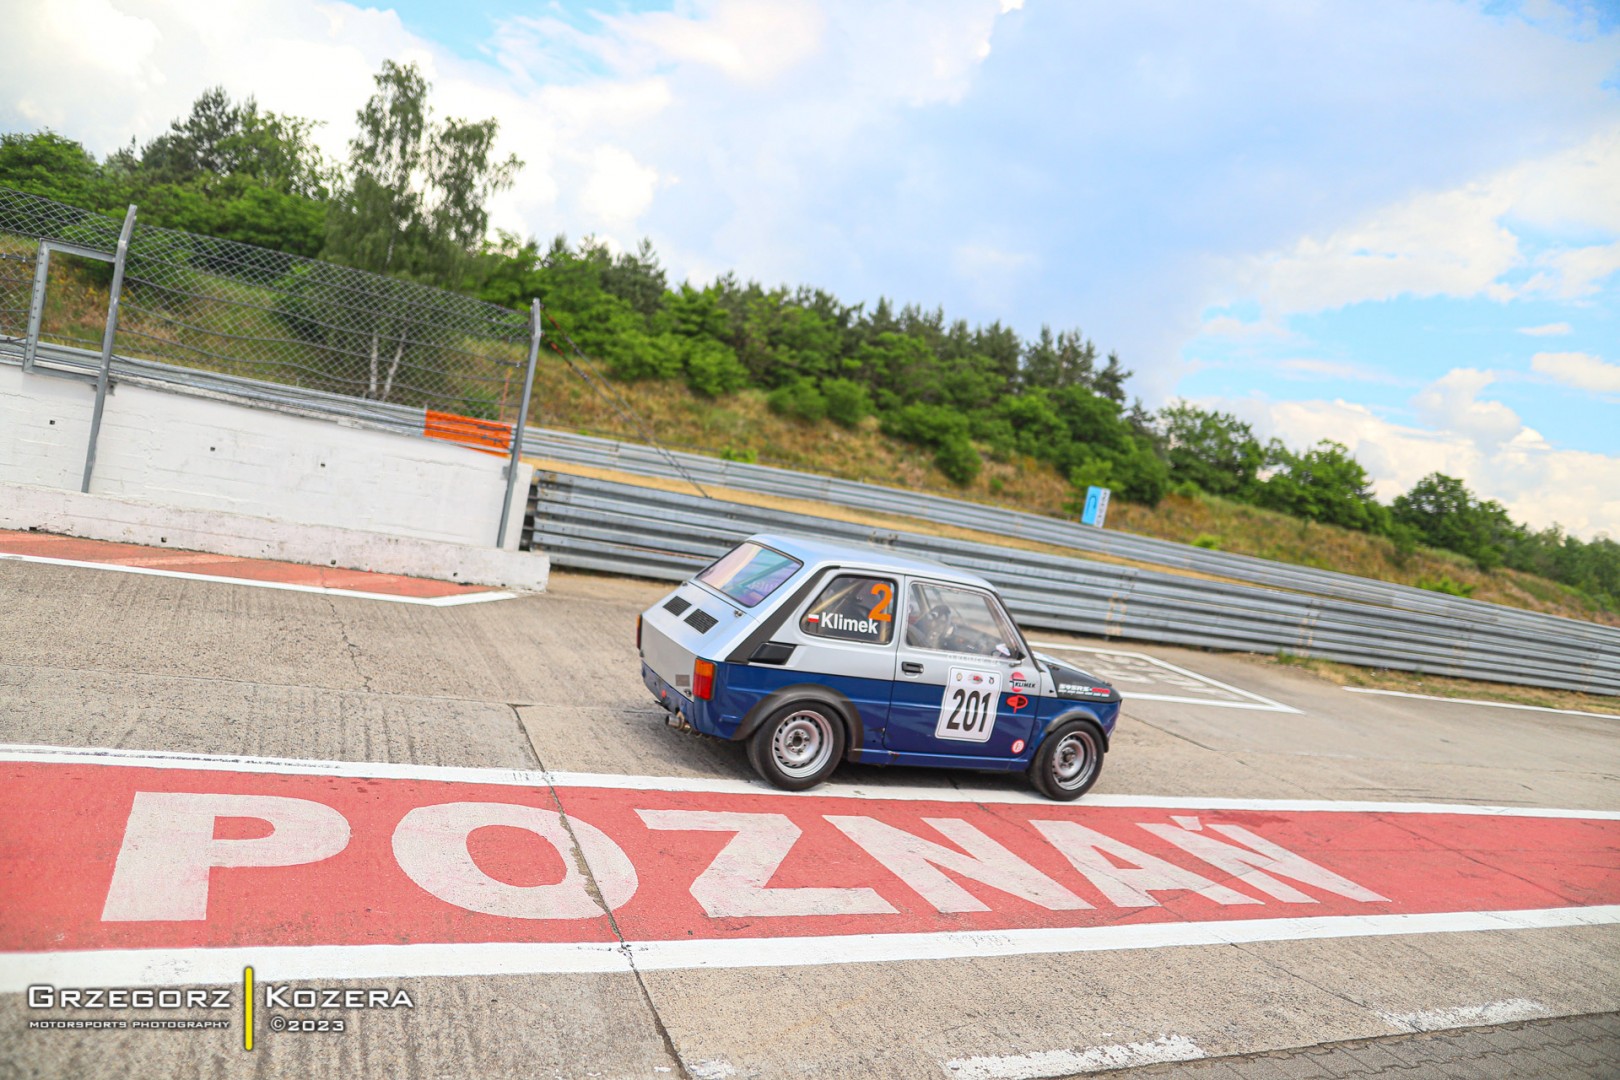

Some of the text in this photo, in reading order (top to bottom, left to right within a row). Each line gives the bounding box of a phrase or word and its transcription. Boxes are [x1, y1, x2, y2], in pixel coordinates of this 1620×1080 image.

[868, 583, 893, 622] 2
[821, 611, 878, 635] Klimek
[1014, 681, 1036, 689] KLIMEK
[946, 688, 992, 733] 201
[101, 790, 1391, 922] POZNAŃ
